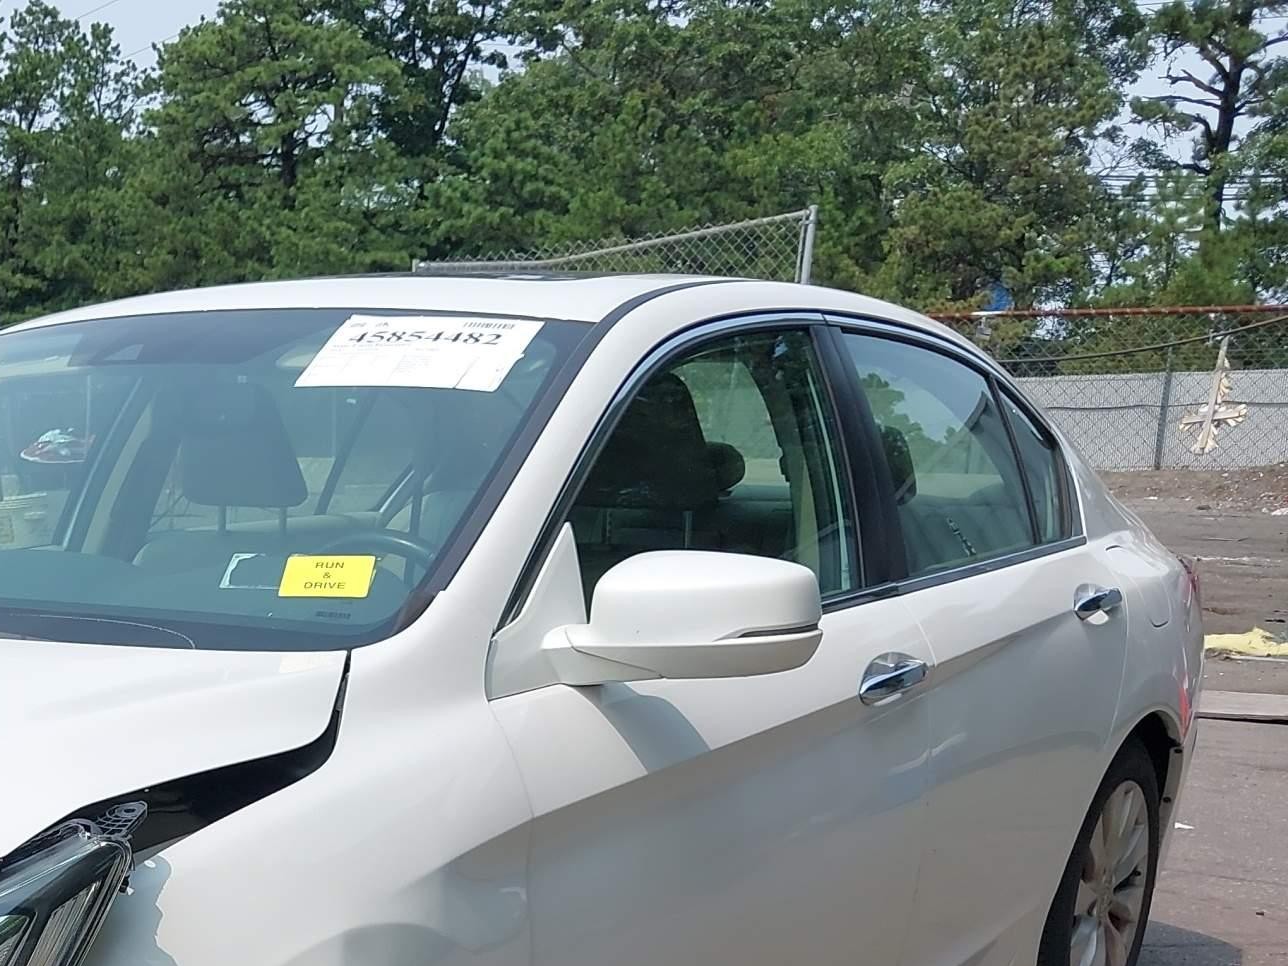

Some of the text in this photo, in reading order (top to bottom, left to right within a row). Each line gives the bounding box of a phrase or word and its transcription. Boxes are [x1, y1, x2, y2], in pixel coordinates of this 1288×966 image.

[349, 330, 503, 346] 45854482
[315, 561, 345, 569] RUN
[322, 571, 332, 579] &
[303, 581, 346, 590] DRIVE
